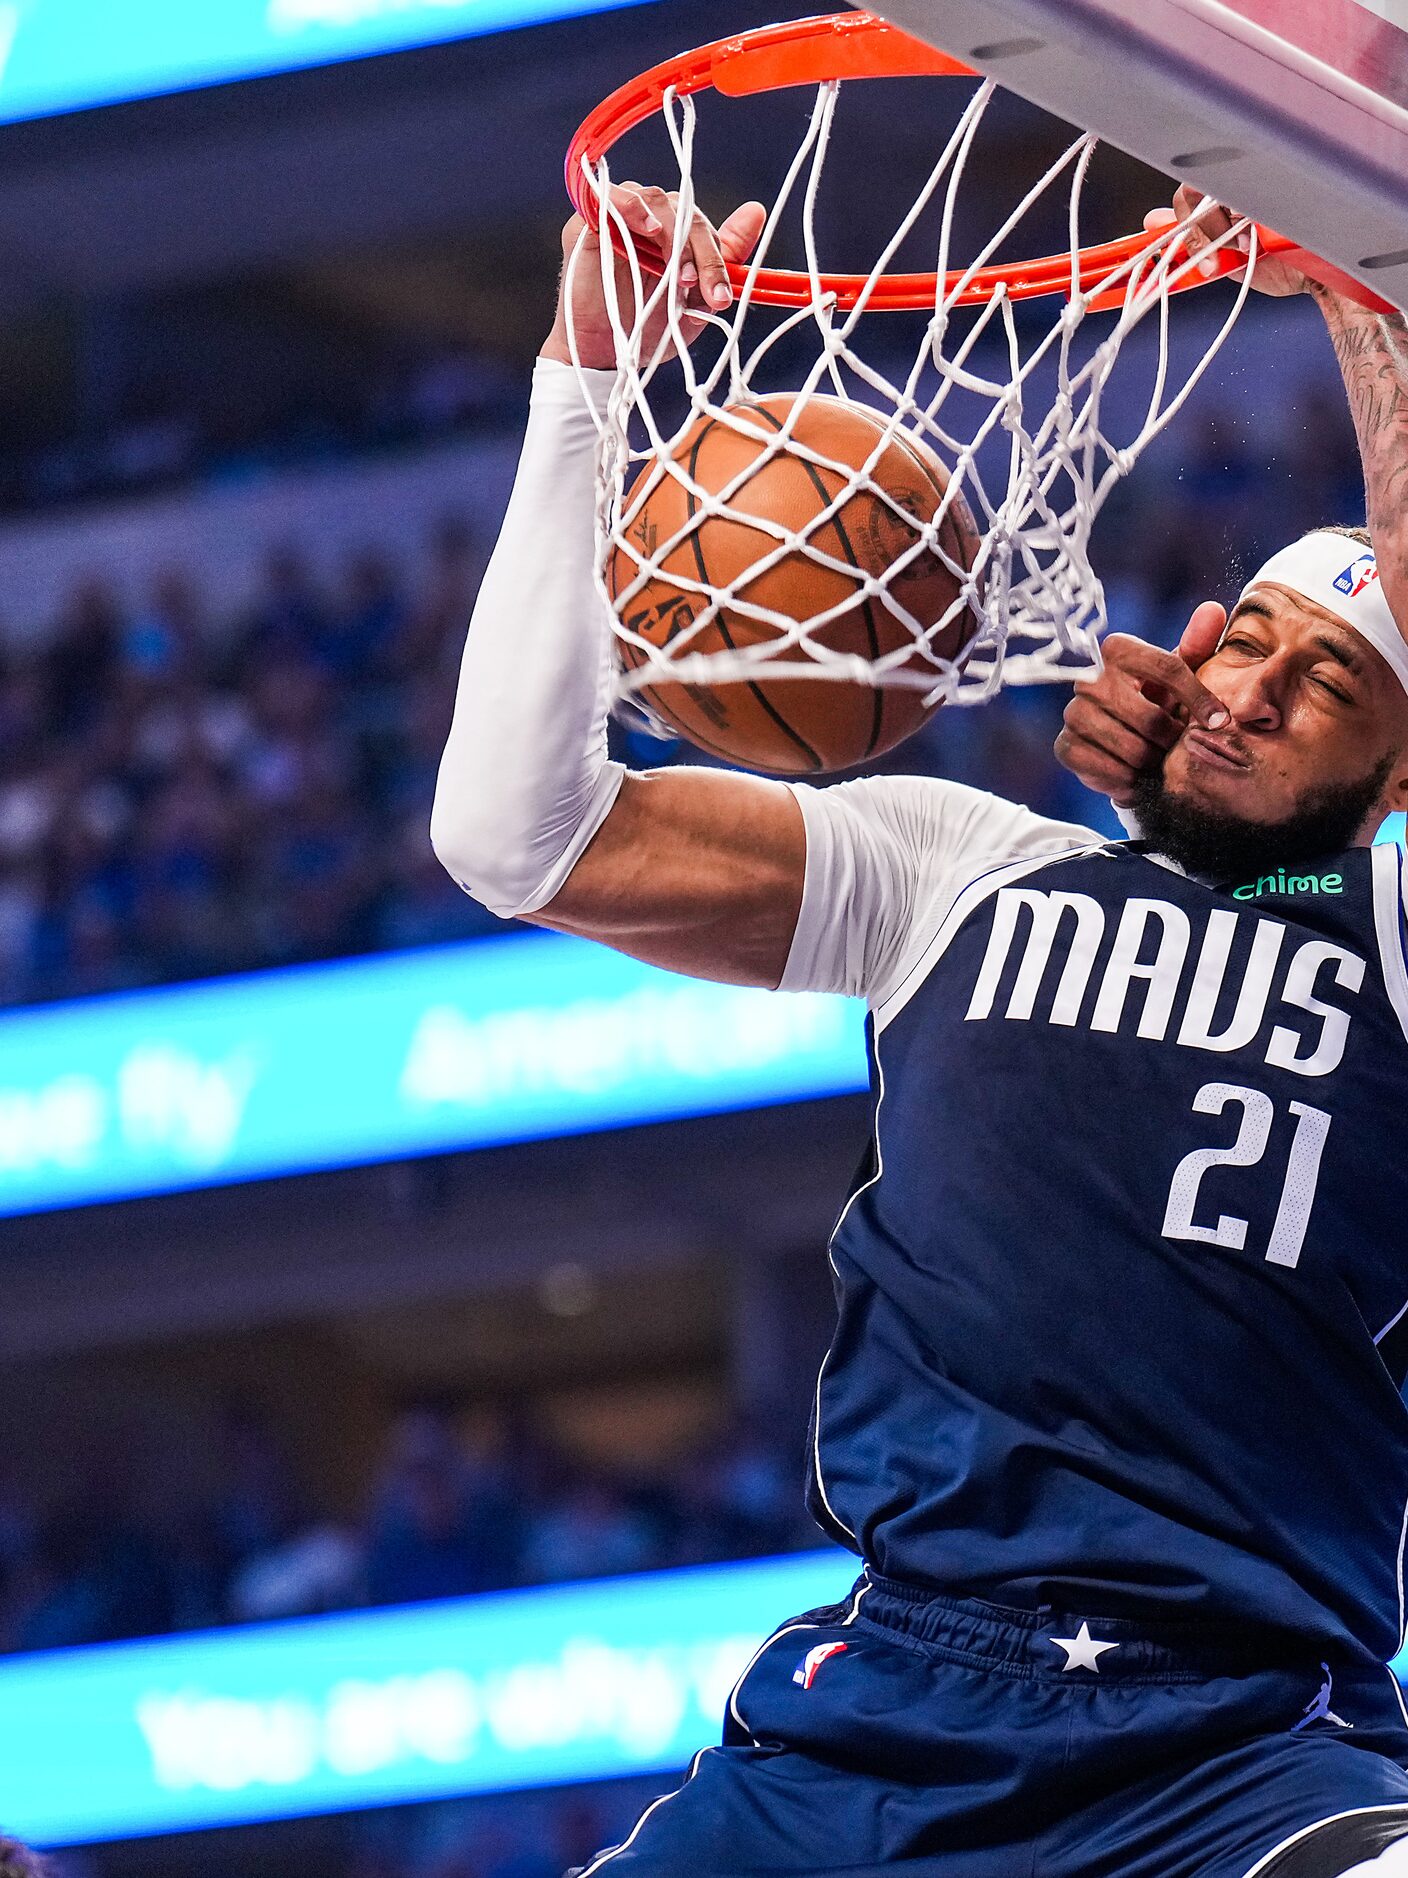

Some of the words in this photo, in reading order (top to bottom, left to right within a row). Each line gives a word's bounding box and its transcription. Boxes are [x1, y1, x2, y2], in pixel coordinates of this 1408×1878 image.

[1334, 577, 1352, 592] NBA
[964, 887, 1367, 1077] MAVS
[1161, 1082, 1332, 1269] 21
